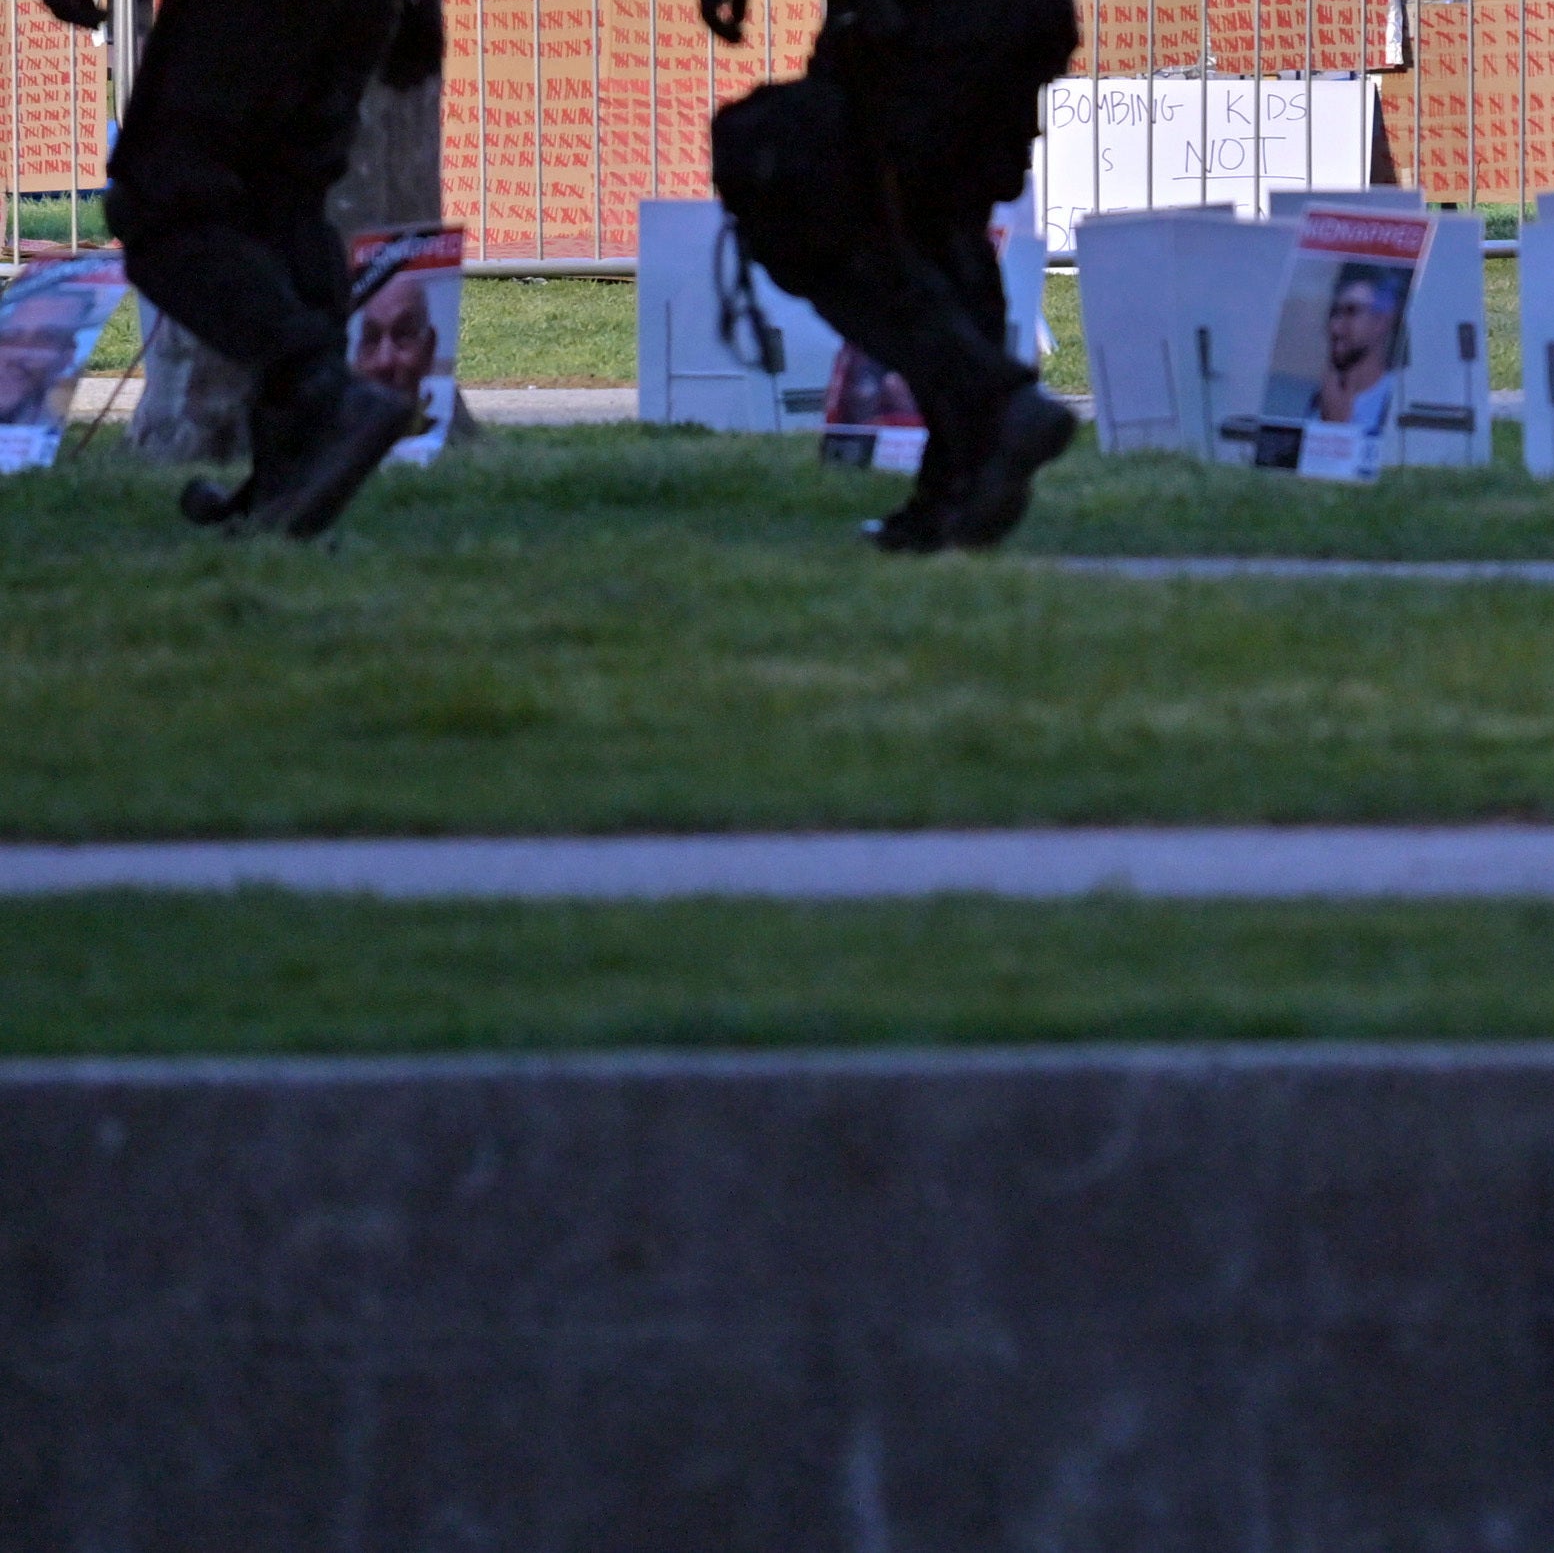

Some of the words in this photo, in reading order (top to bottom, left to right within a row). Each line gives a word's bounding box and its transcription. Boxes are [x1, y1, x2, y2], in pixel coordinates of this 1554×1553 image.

[1052, 88, 1184, 128] BOMBING
[1227, 90, 1308, 125] KDS
[1185, 137, 1287, 175] NOT
